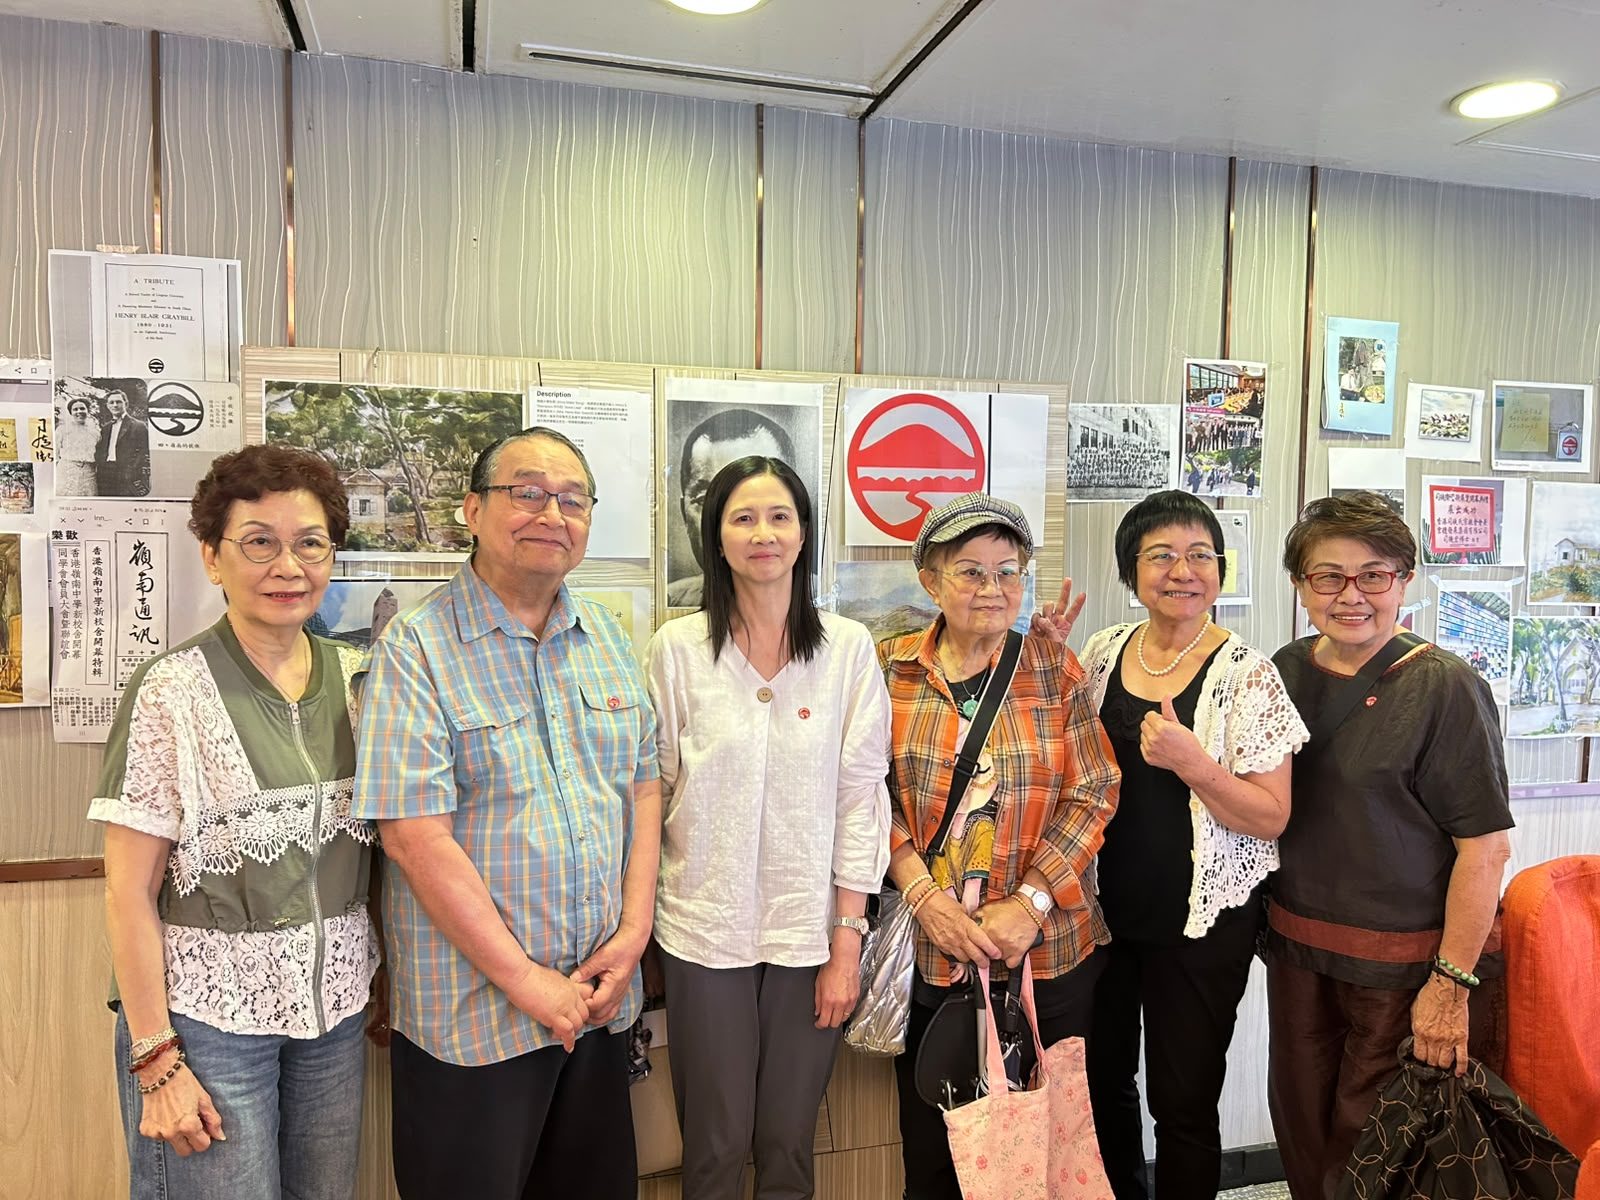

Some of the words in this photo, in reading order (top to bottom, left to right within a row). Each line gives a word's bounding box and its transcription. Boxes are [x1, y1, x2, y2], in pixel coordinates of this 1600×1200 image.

[161, 314, 195, 322] GRAYBILL
[536, 390, 571, 398] Description
[91, 546, 105, 678] 香港嶺南中學新校舍開幕特輯
[129, 539, 160, 645] 嶺南通訊
